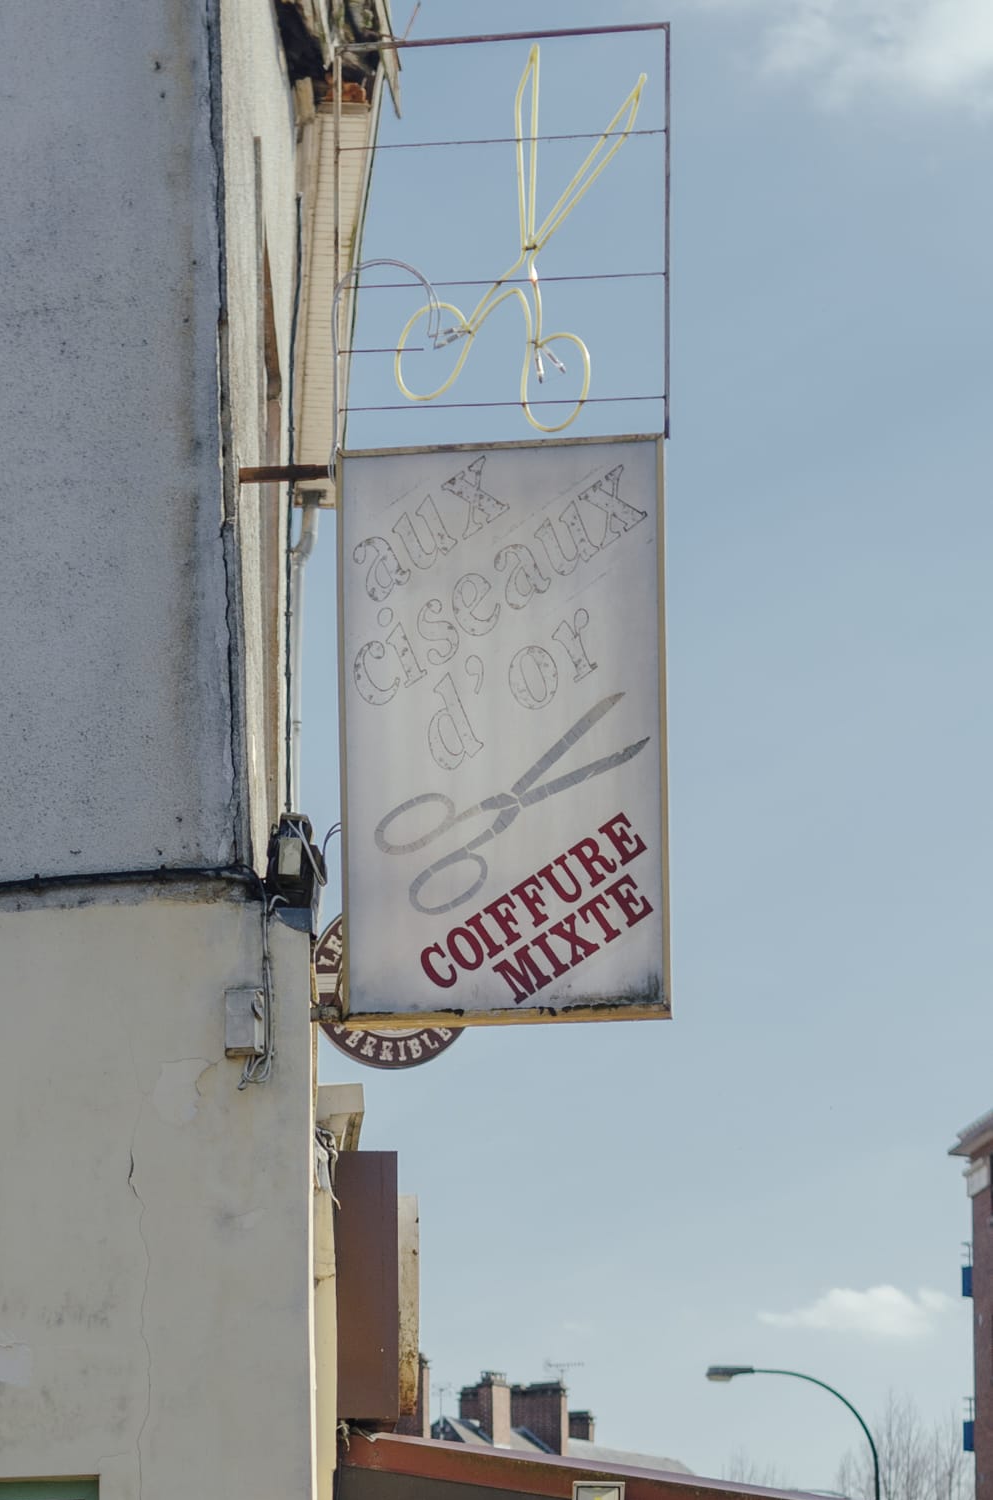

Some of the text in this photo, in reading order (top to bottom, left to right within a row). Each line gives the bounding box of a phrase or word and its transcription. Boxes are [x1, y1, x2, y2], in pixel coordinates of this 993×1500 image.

[353, 455, 510, 601] aux
[353, 464, 648, 705] ciseaux
[427, 608, 598, 770] d'or
[420, 811, 648, 988] COIFFURE
[493, 873, 654, 1004] MIXTE
